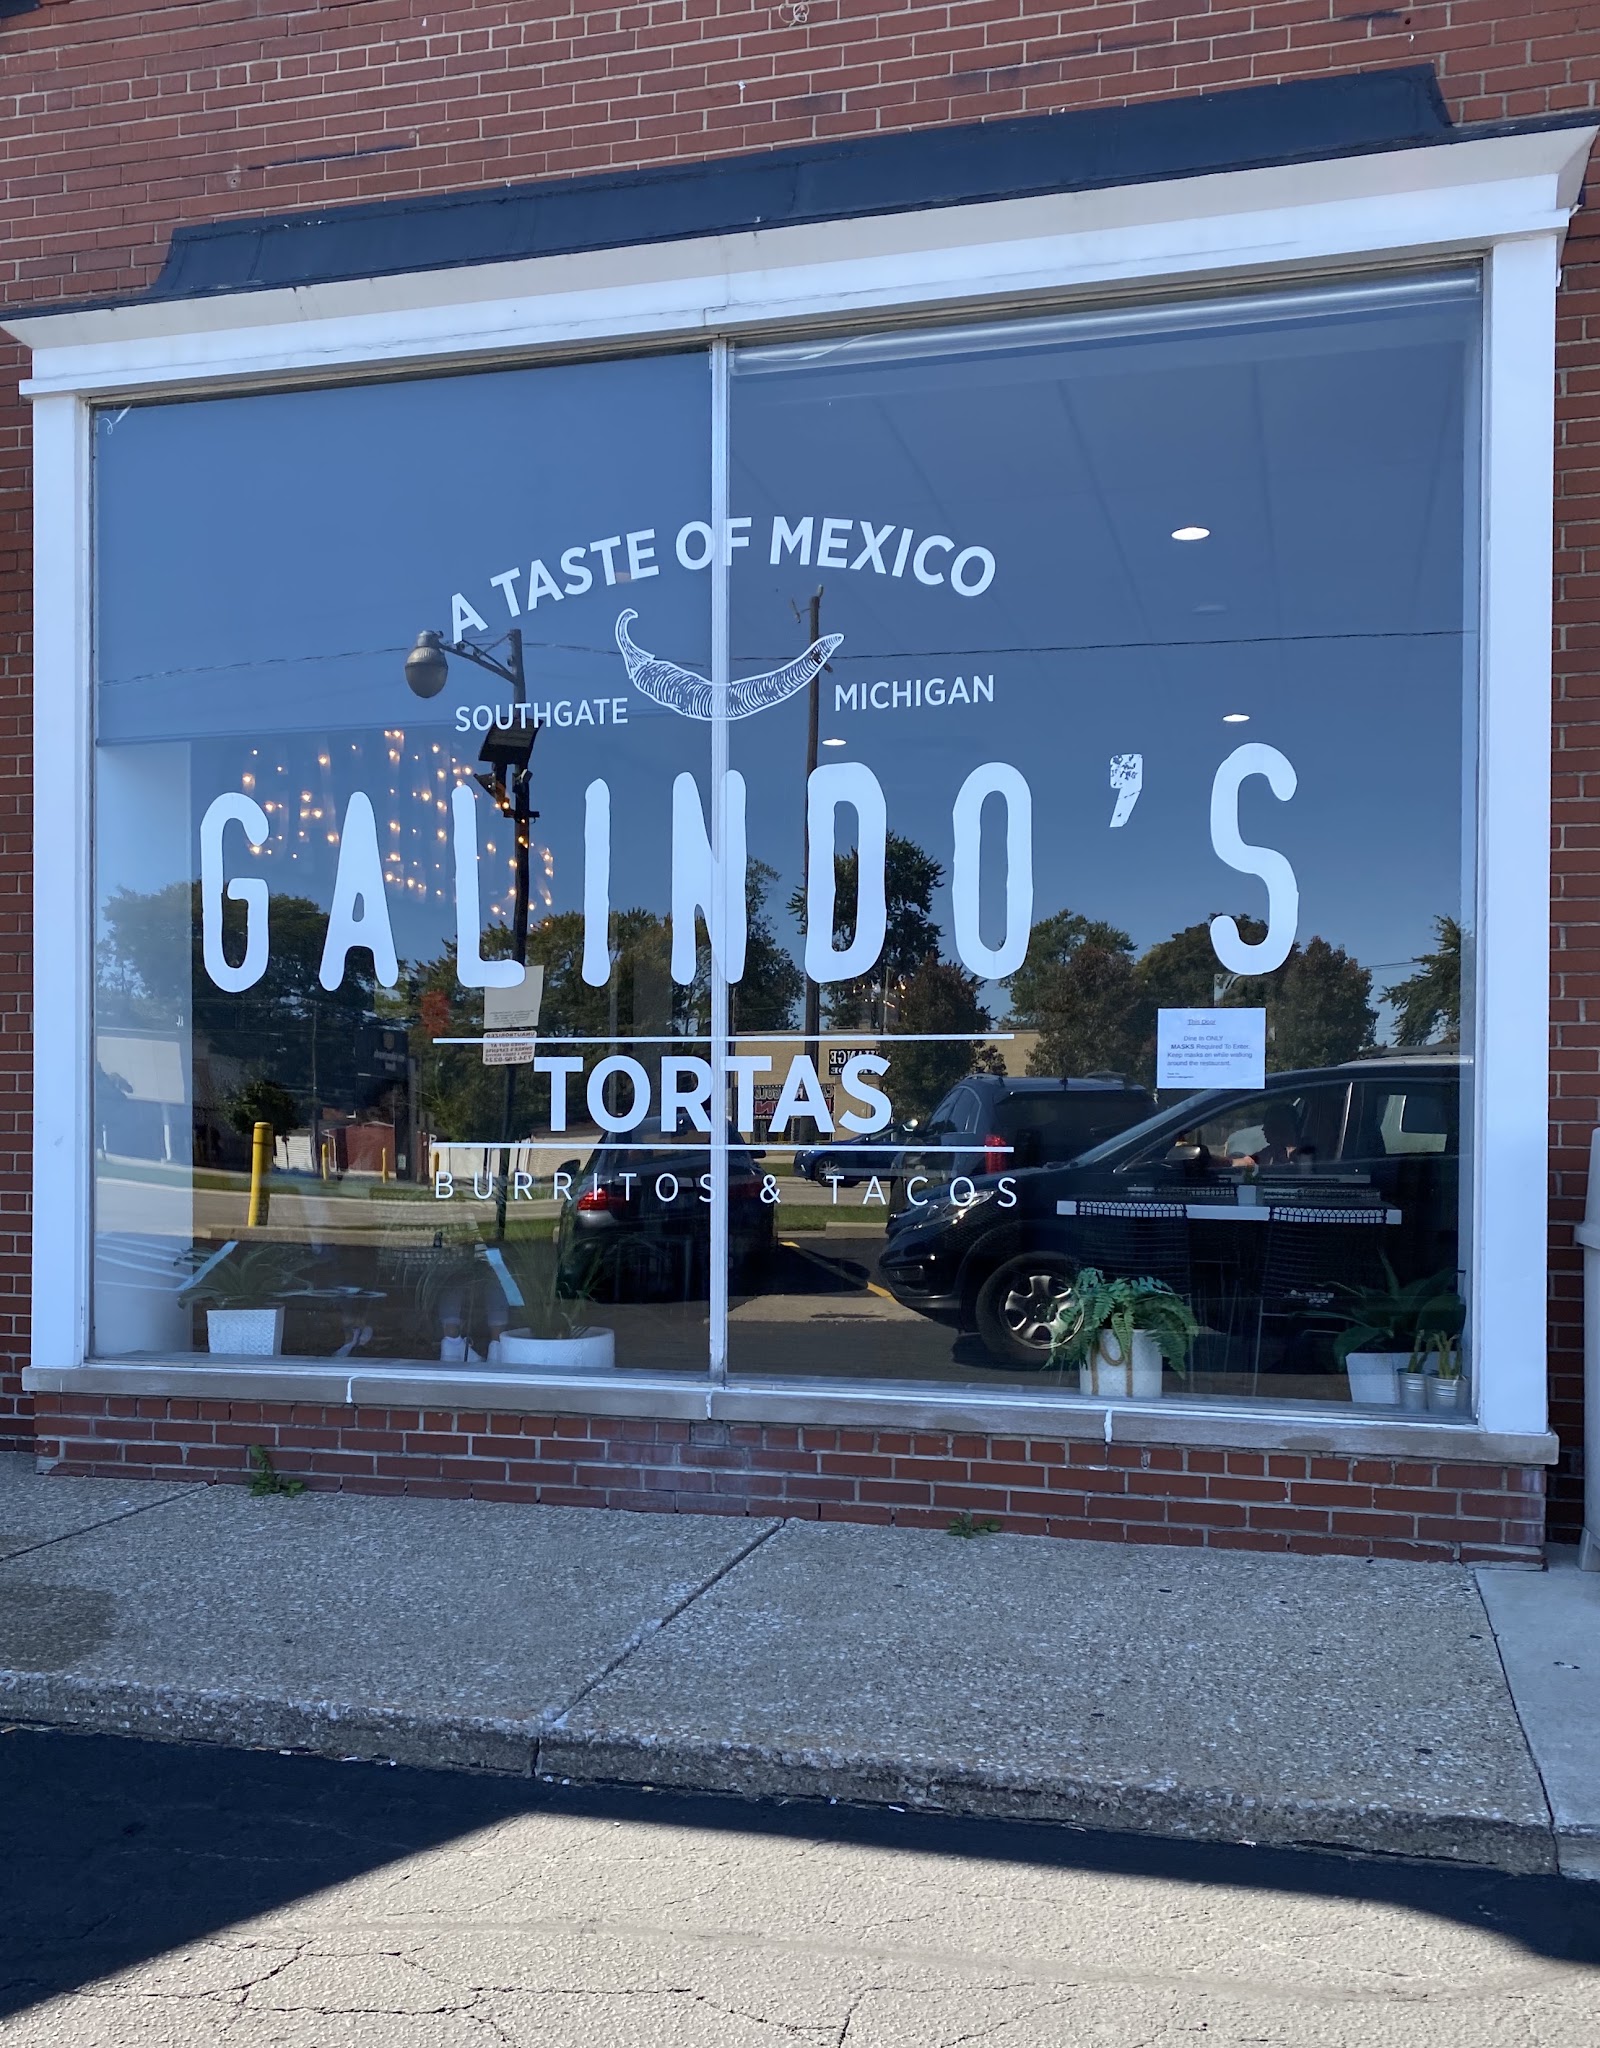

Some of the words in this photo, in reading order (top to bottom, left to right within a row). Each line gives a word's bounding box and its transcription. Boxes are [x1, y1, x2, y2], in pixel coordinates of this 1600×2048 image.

[450, 592, 488, 643] A
[490, 528, 660, 618] TASTE
[675, 516, 752, 571] OF
[769, 515, 996, 597] MEXICO
[454, 697, 629, 732] SOUTHGATE
[834, 674, 995, 711] MICHIGAN
[200, 742, 1299, 993] GALINDO'S
[533, 1055, 892, 1134] TORTAS
[435, 1170, 718, 1202] BURRITOS
[760, 1177, 781, 1205] &
[825, 1174, 1018, 1208] TACOS
